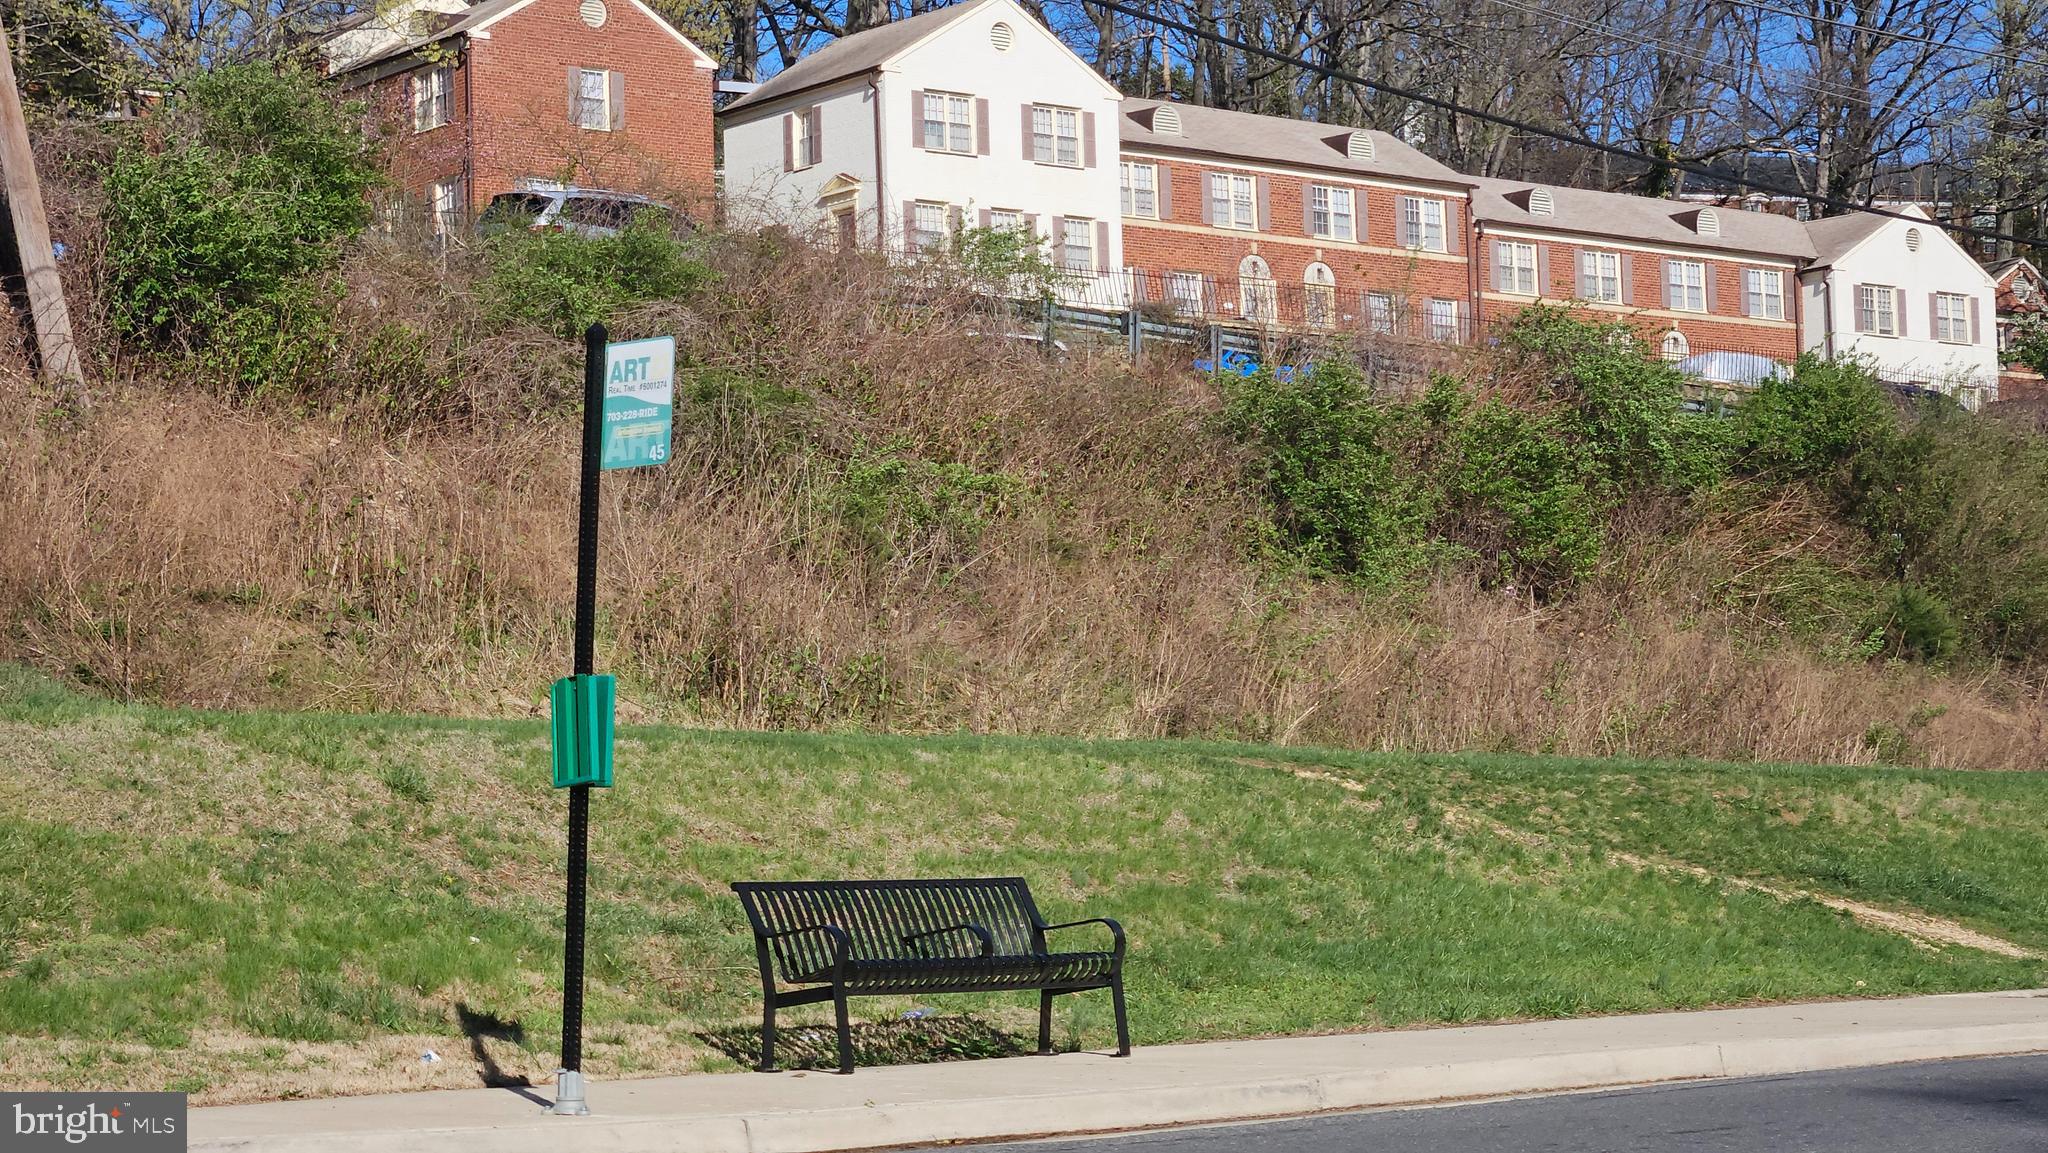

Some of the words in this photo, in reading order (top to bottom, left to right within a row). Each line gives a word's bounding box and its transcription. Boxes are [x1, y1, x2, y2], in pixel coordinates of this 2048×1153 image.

[609, 356, 651, 384] ART
[607, 406, 658, 422] 703-228-RIDE
[648, 443, 665, 461] 45
